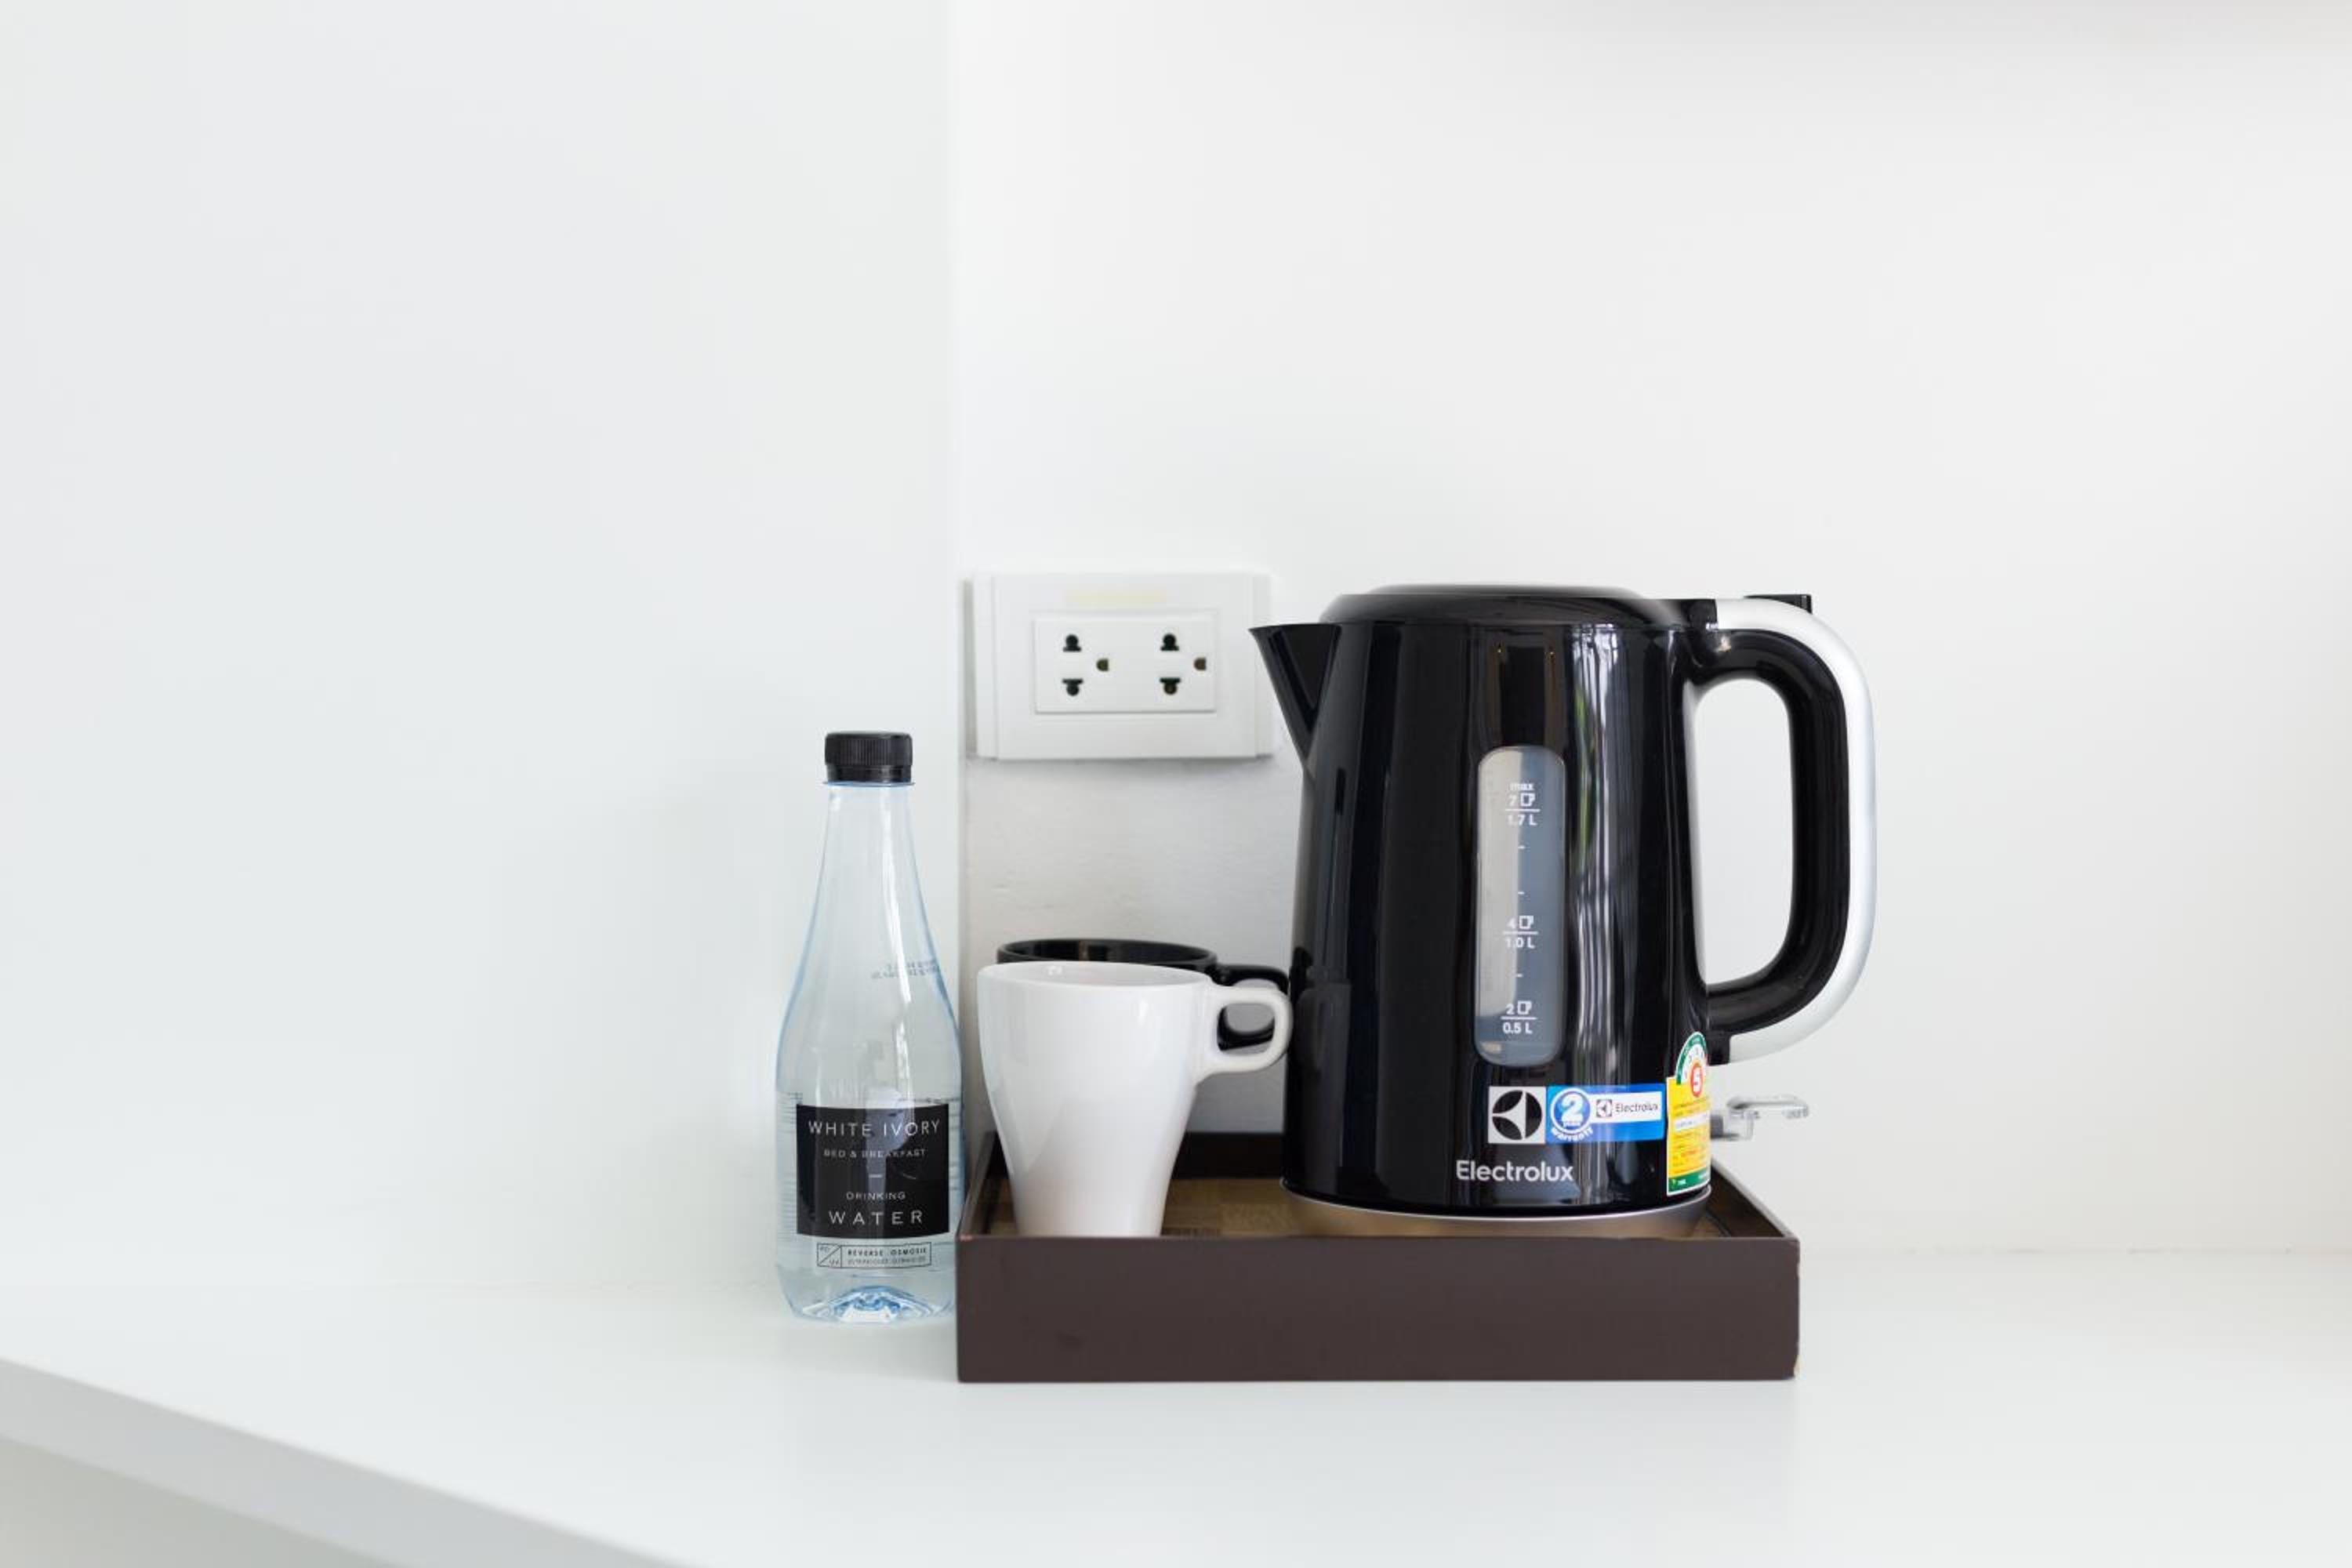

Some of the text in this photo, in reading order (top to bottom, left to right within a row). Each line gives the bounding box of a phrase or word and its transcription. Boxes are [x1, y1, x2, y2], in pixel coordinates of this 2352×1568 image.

[1508, 814, 1537, 826] 1.7 L
[1507, 917, 1516, 929] 4
[1505, 937, 1536, 949] 1.0 L
[1505, 1003, 1515, 1015] 2
[1503, 1022, 1534, 1034] 0.5 L
[808, 1119, 940, 1137] WHITE IVORY
[823, 1149, 846, 1158] BED
[862, 1149, 926, 1158] BREAKFAST
[1456, 1160, 1574, 1182] Electrolux
[846, 1191, 906, 1201] DRINKING
[829, 1210, 923, 1225] WATER
